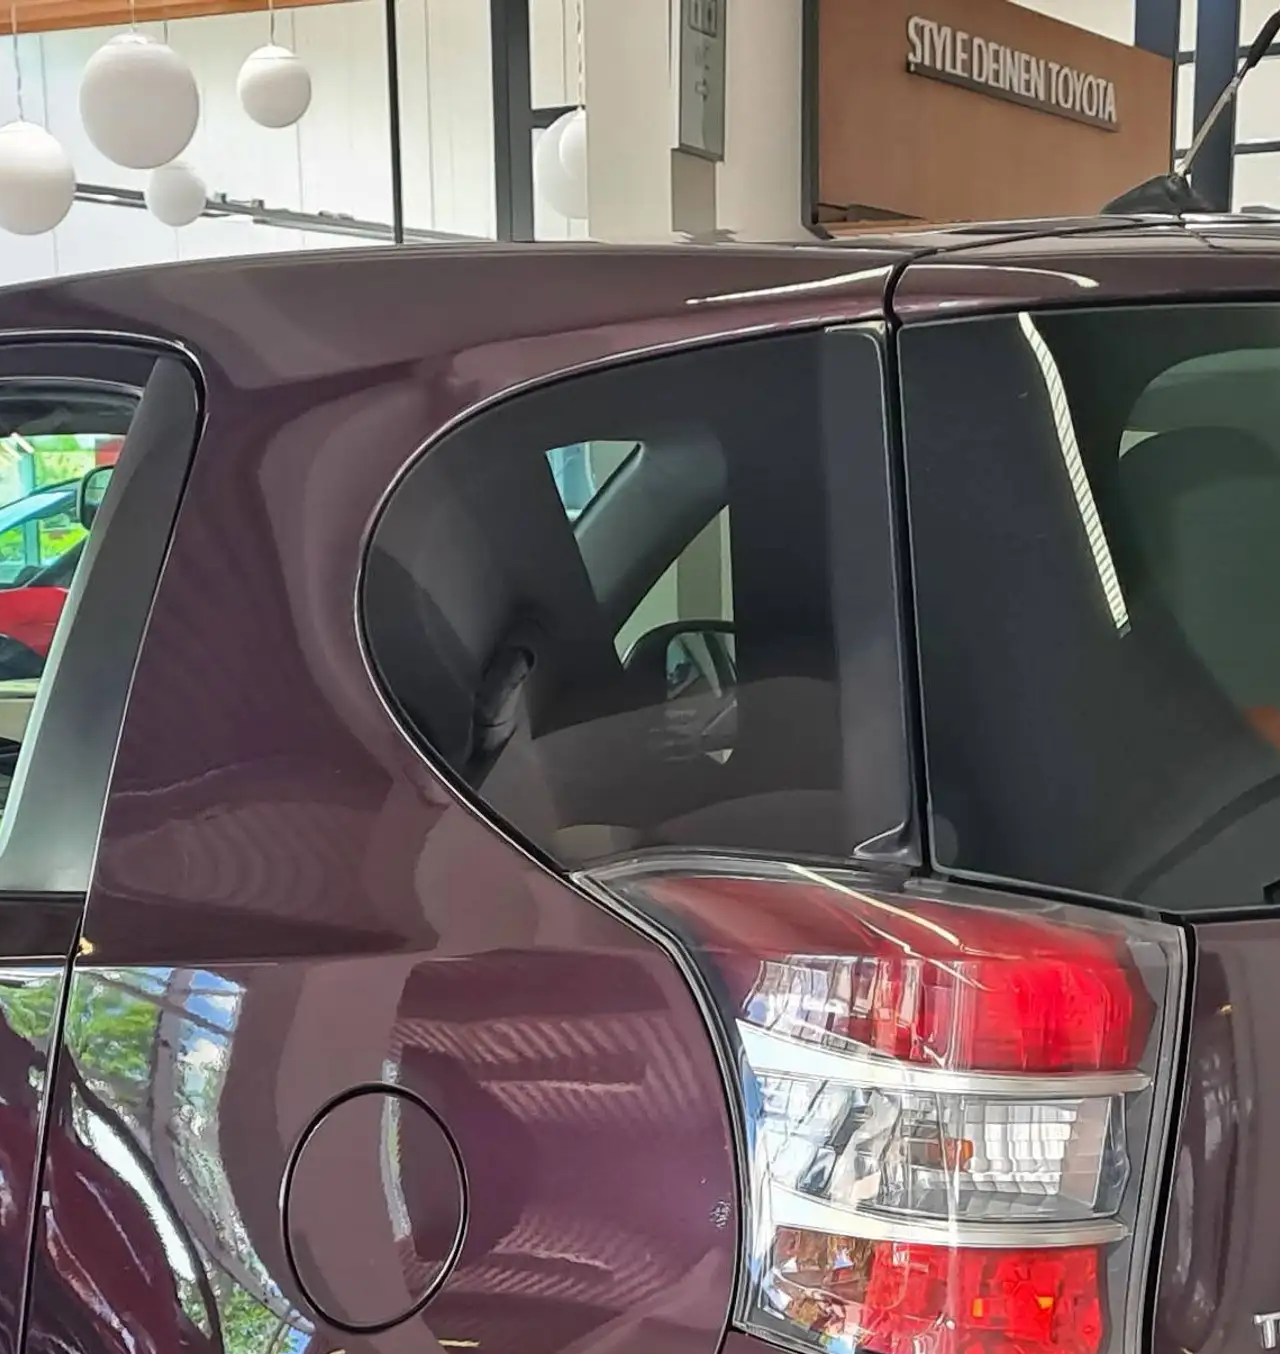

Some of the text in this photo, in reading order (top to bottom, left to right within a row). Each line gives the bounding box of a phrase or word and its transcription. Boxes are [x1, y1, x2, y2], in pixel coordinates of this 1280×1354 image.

[908, 16, 1117, 123] STYLE DEINEN TOYOTA
